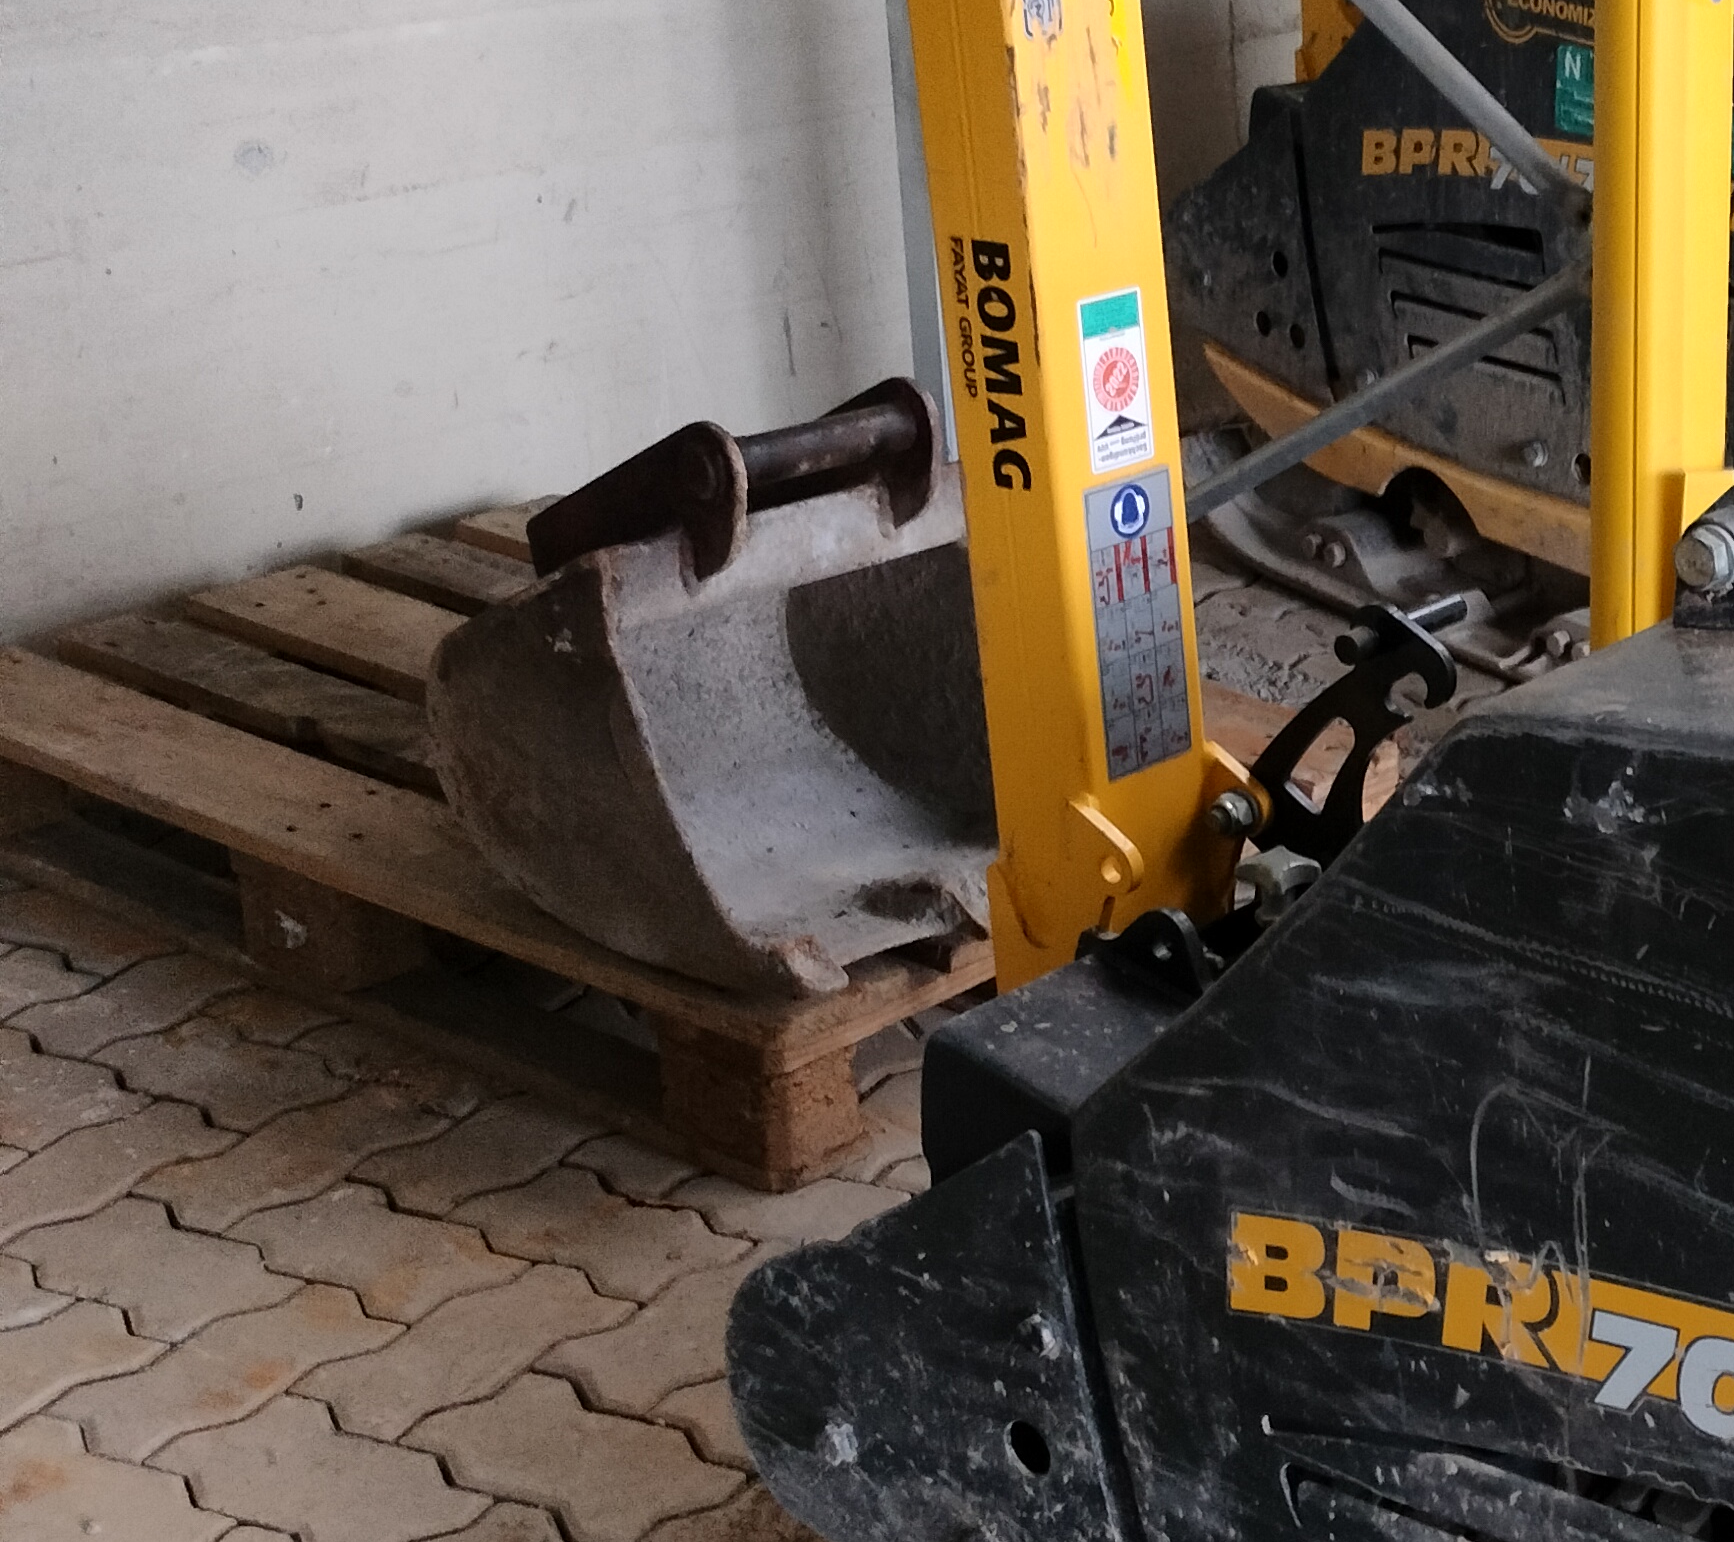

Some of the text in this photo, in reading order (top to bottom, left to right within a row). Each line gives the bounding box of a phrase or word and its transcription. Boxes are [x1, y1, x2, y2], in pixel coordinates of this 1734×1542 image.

[1362, 129, 1484, 177] BPR
[950, 235, 979, 399] FAYAT GROUP
[971, 238, 1032, 492] BOMAG
[1105, 360, 1129, 398] 2022
[1229, 1212, 1576, 1372] BPR
